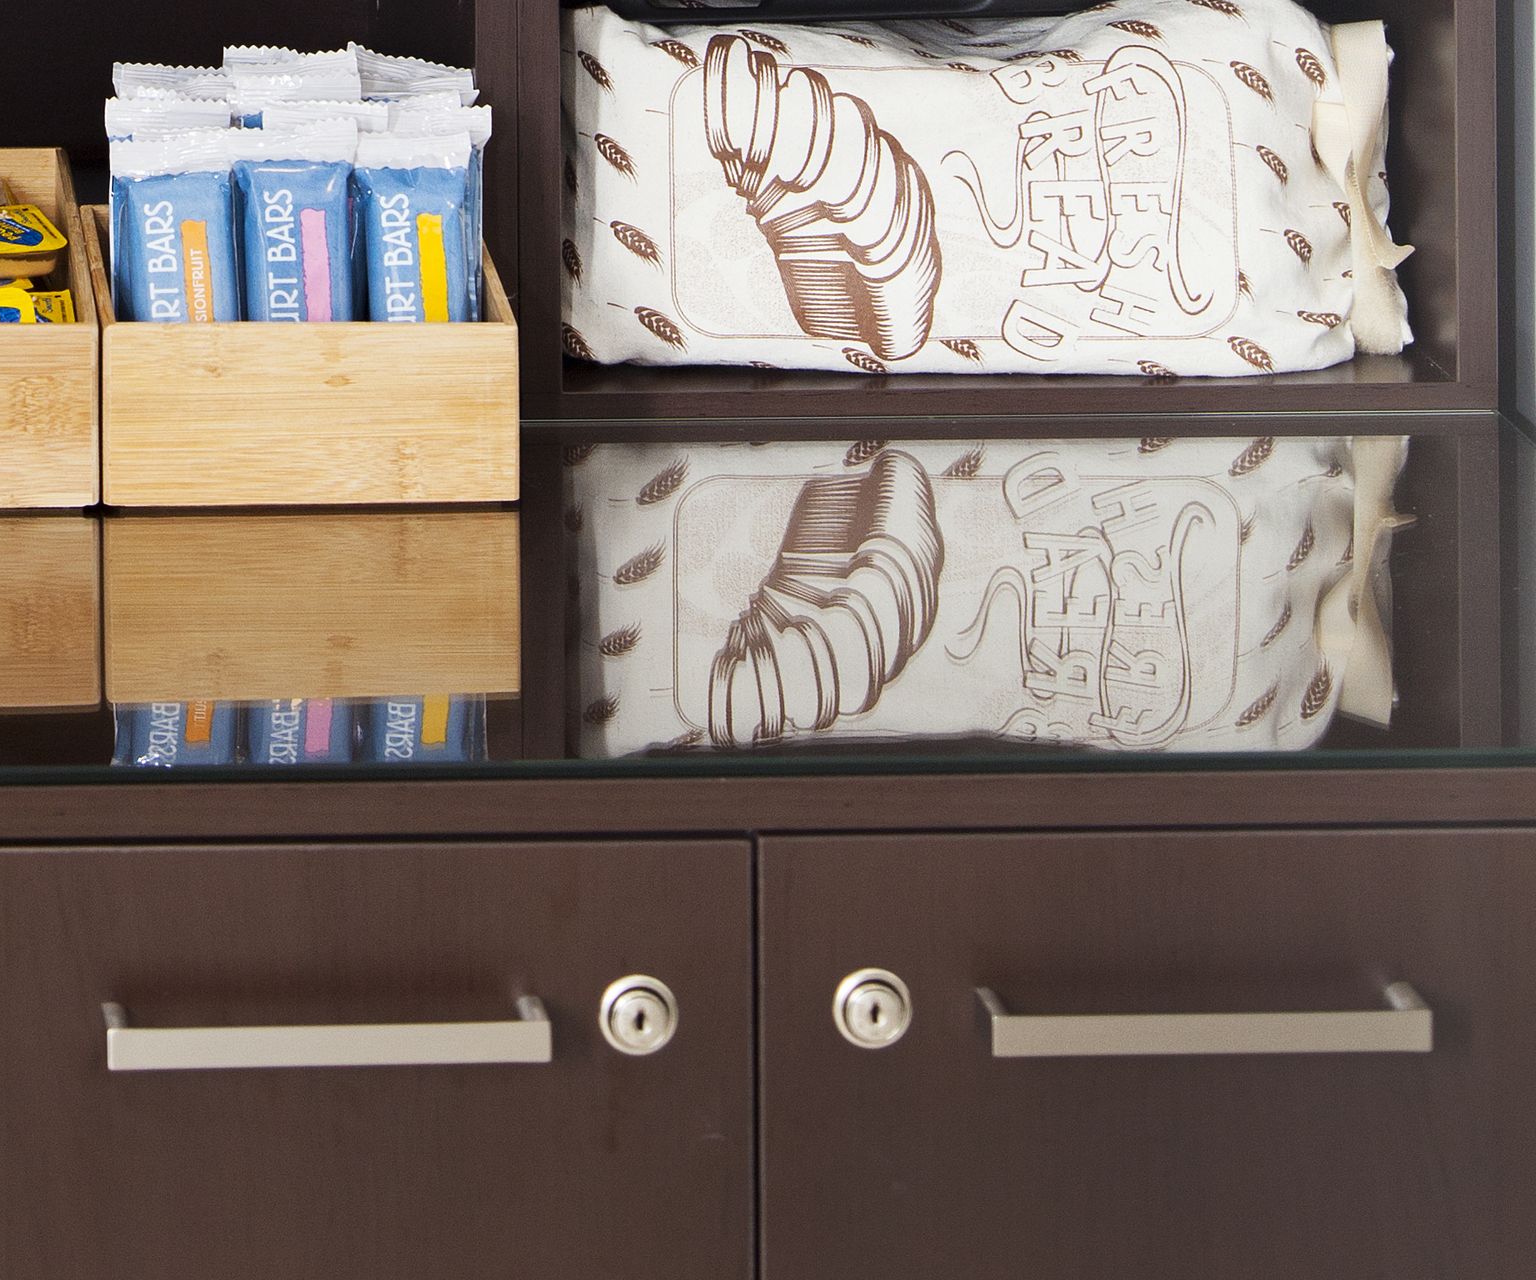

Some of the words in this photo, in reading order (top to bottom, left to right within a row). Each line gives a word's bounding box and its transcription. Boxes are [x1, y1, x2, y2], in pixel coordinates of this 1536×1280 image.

[144, 200, 177, 272] BARS
[264, 190, 297, 262] BARS
[380, 193, 414, 266] BARS
[990, 60, 1105, 362] BREAD
[1082, 62, 1172, 338] FRESH
